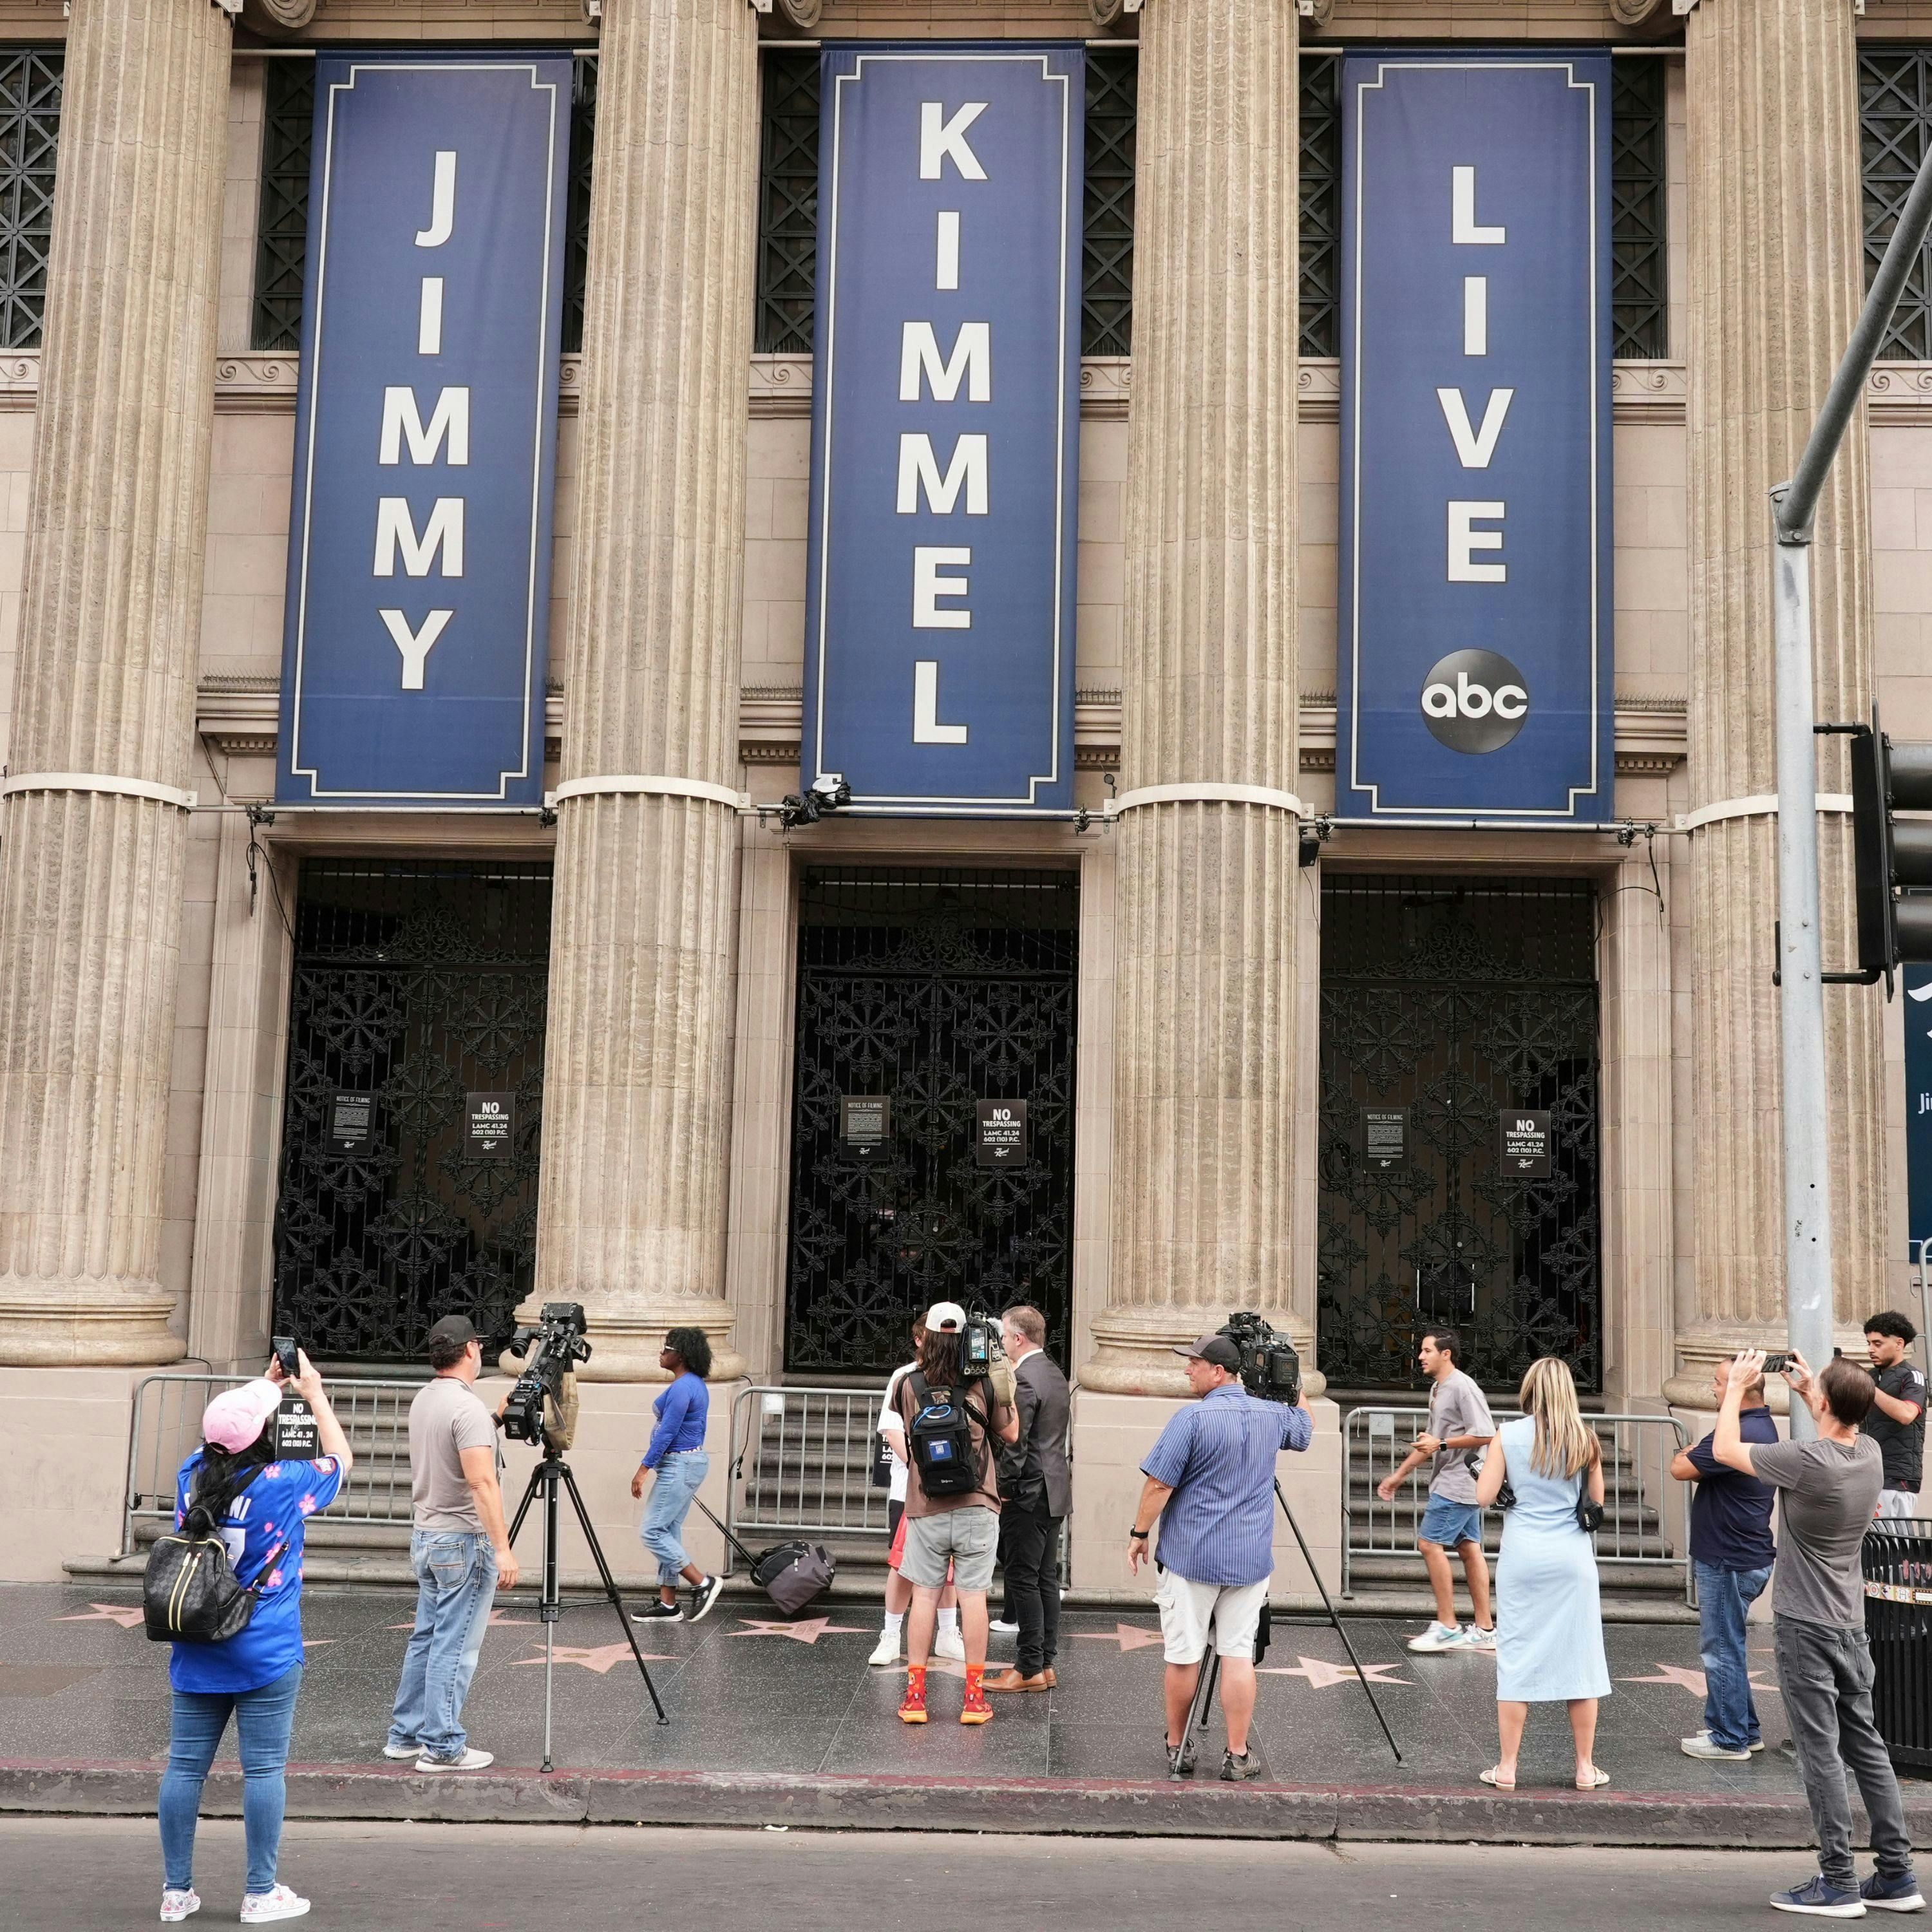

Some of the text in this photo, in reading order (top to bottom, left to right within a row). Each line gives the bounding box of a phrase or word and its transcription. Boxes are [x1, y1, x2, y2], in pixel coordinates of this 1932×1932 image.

[1437, 167, 1513, 582] LIVE
[374, 152, 468, 688] JIMMY
[897, 103, 990, 743] KIMMEL
[1421, 672, 1528, 719] abc
[482, 1102, 500, 1113] NO
[1918, 1092, 1932, 1114] Ji
[993, 1108, 1011, 1121] NO
[1517, 1119, 1535, 1132] NO
[293, 1403, 304, 1414] NO
